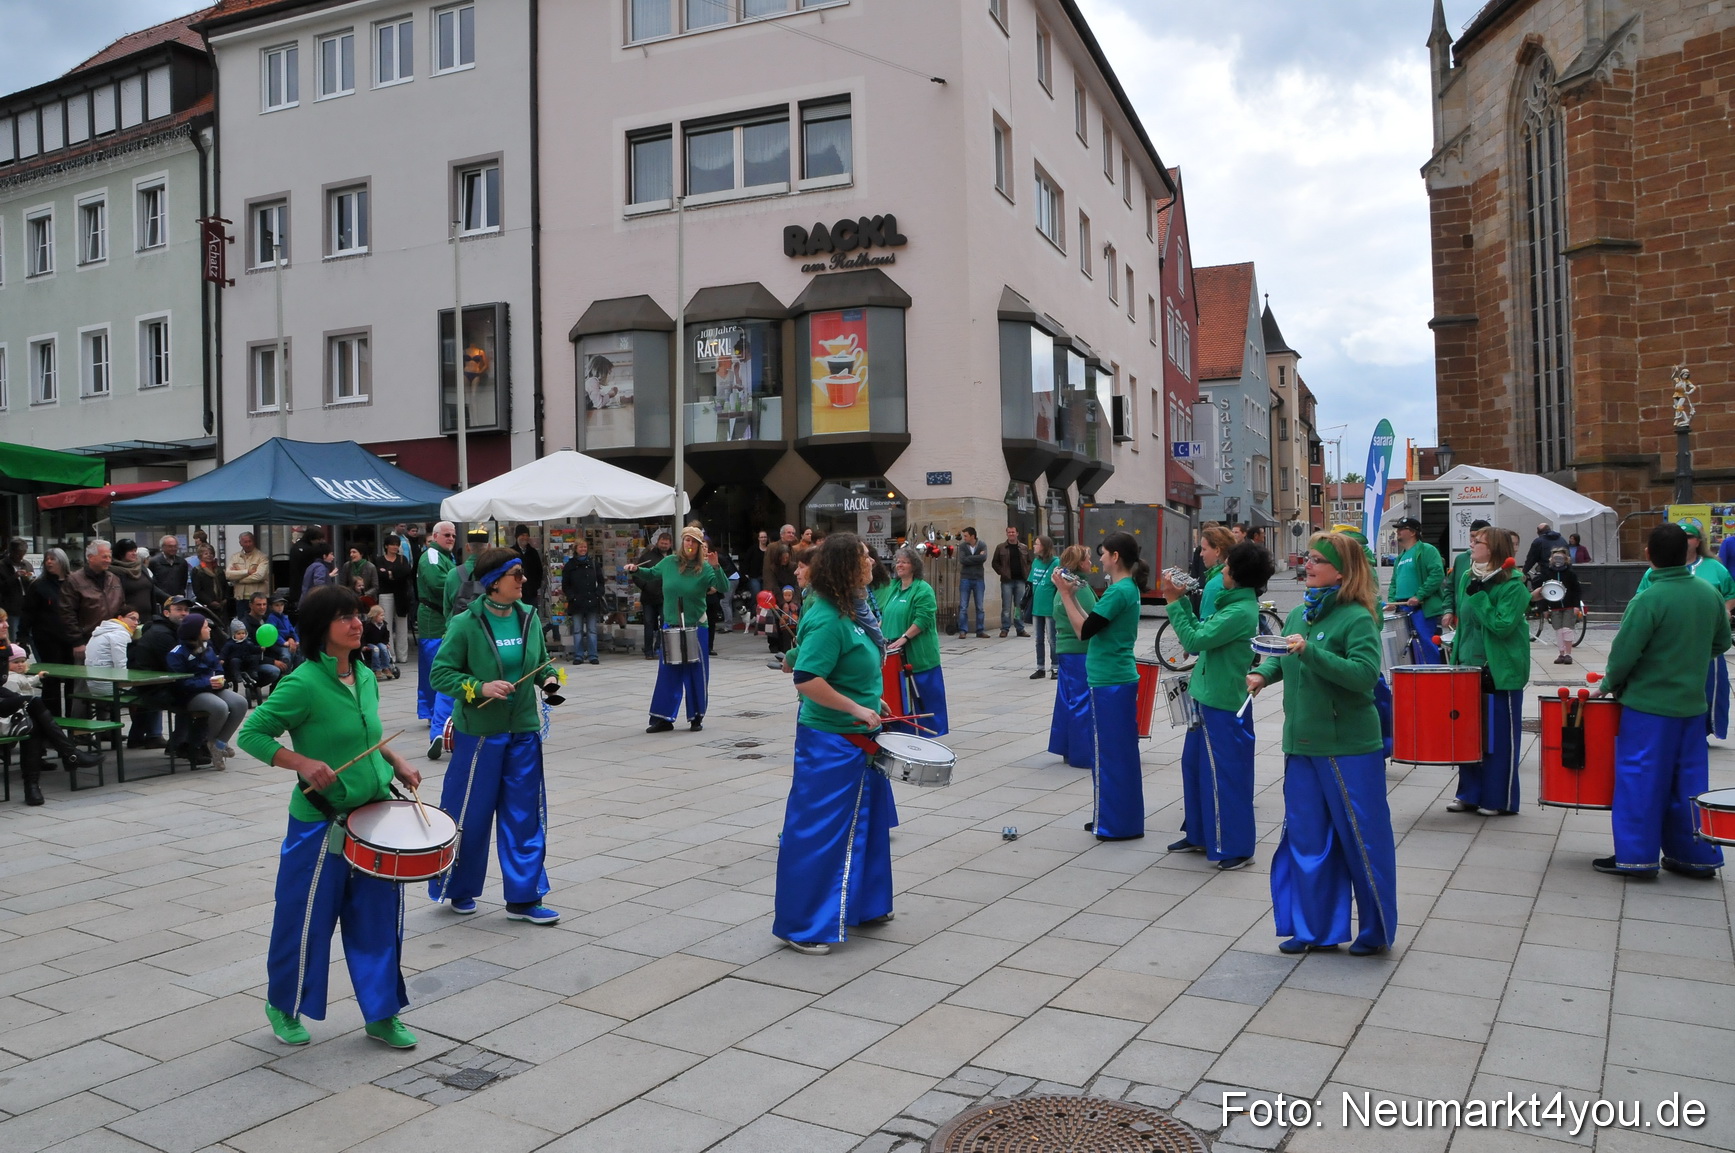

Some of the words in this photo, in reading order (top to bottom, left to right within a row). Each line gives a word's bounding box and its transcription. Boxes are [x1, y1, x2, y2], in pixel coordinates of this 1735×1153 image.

[783, 213, 908, 258] RACKL
[208, 231, 221, 278] Achatz
[801, 262, 826, 273] am
[829, 252, 896, 270] Rathaus
[697, 338, 732, 358] RACKL
[1220, 398, 1234, 483] satzke
[312, 477, 401, 500] RACKL
[844, 498, 869, 511] RACKL
